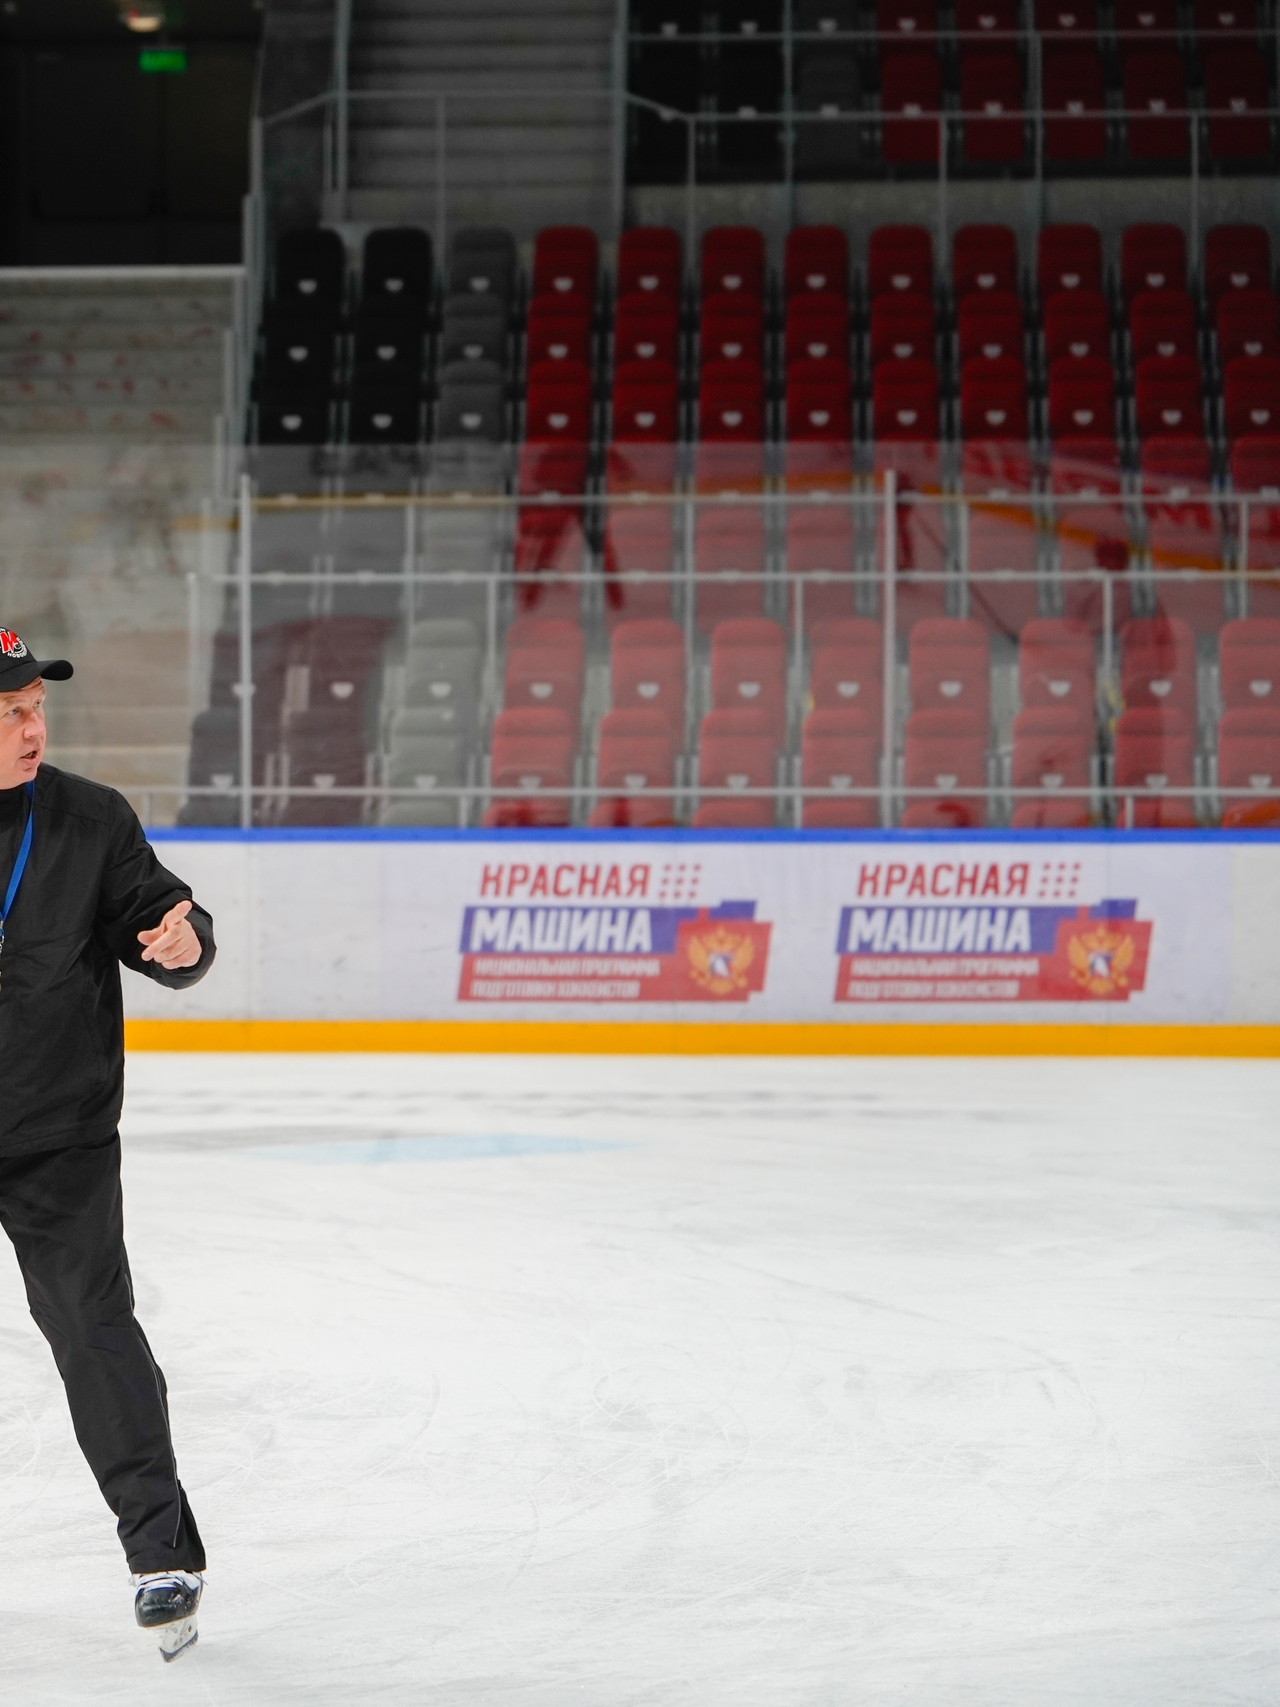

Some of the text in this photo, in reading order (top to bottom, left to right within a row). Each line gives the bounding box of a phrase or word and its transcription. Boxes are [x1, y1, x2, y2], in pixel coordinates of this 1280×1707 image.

[479, 864, 652, 898] КРАСНАЯ
[857, 863, 1030, 898] КРАСНАЯ
[469, 907, 653, 952] МАШИНА
[846, 907, 1032, 952] МАШИНА
